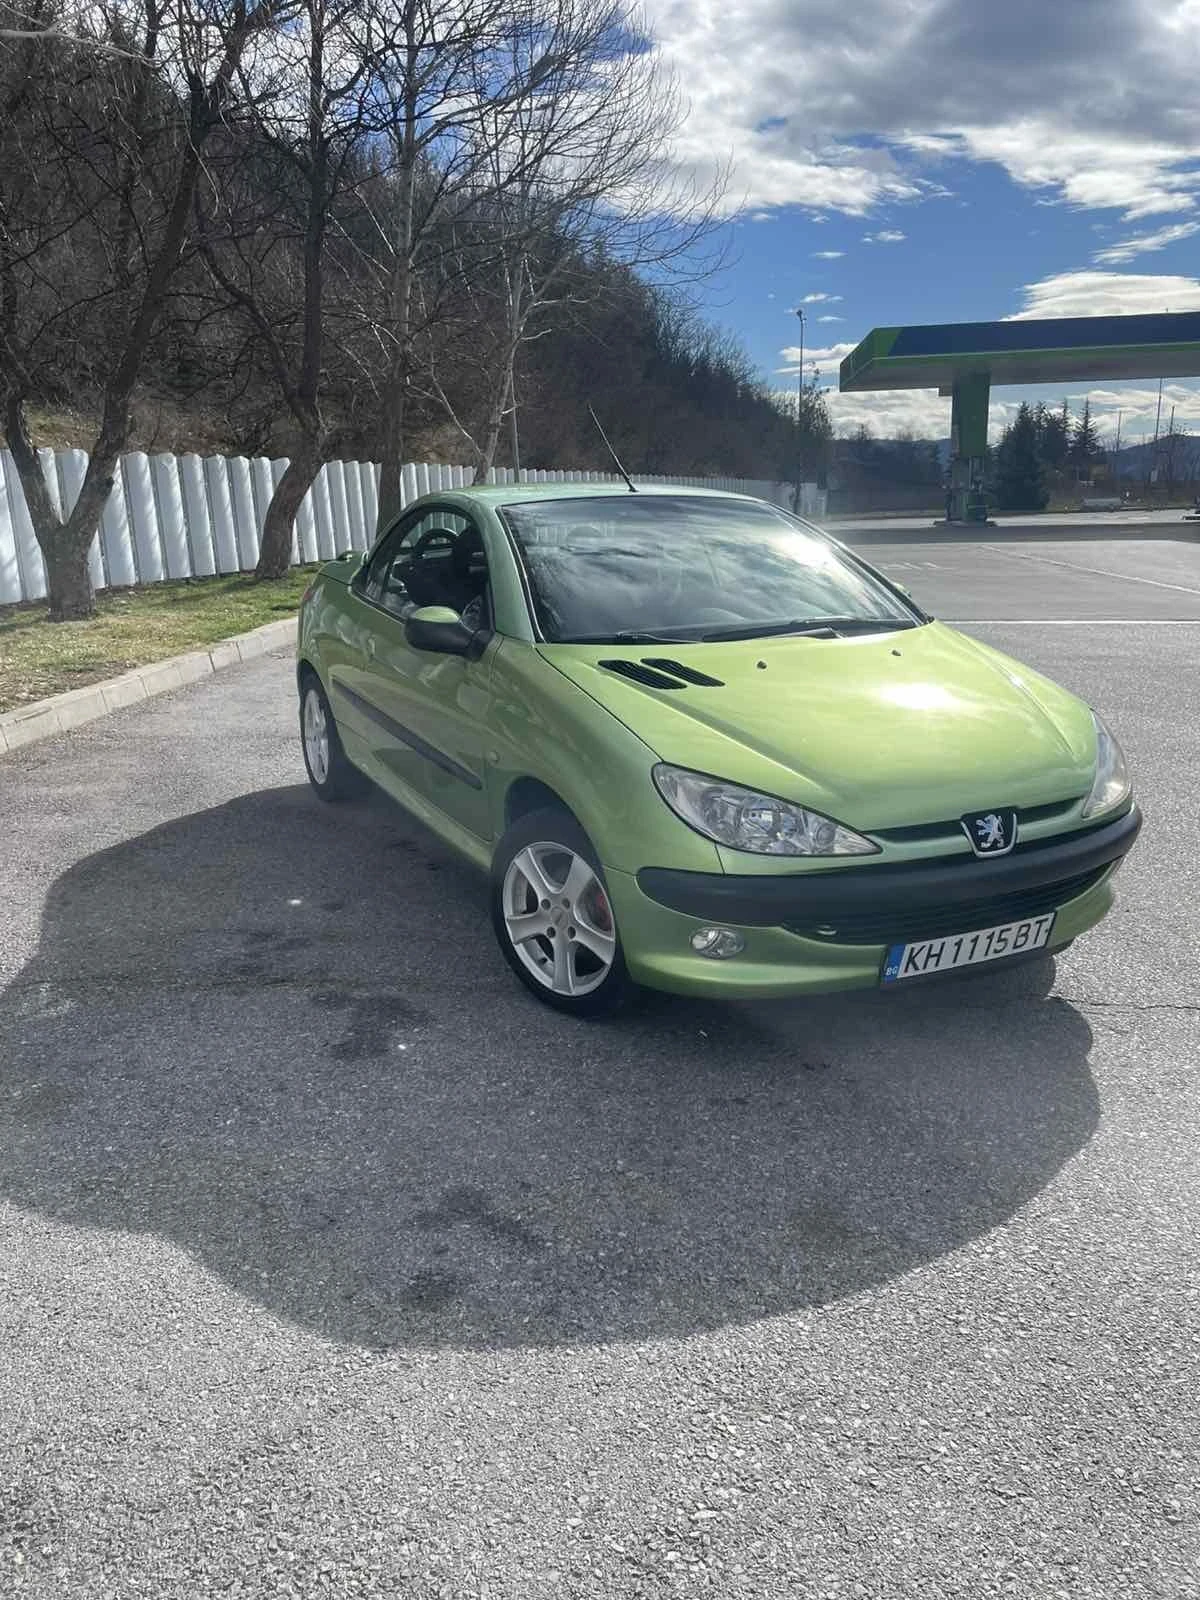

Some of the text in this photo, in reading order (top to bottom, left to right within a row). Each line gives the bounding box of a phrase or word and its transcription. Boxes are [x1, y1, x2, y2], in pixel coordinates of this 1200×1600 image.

[904, 918, 1048, 973] KH 1115 BT
[885, 966, 898, 976] BG
